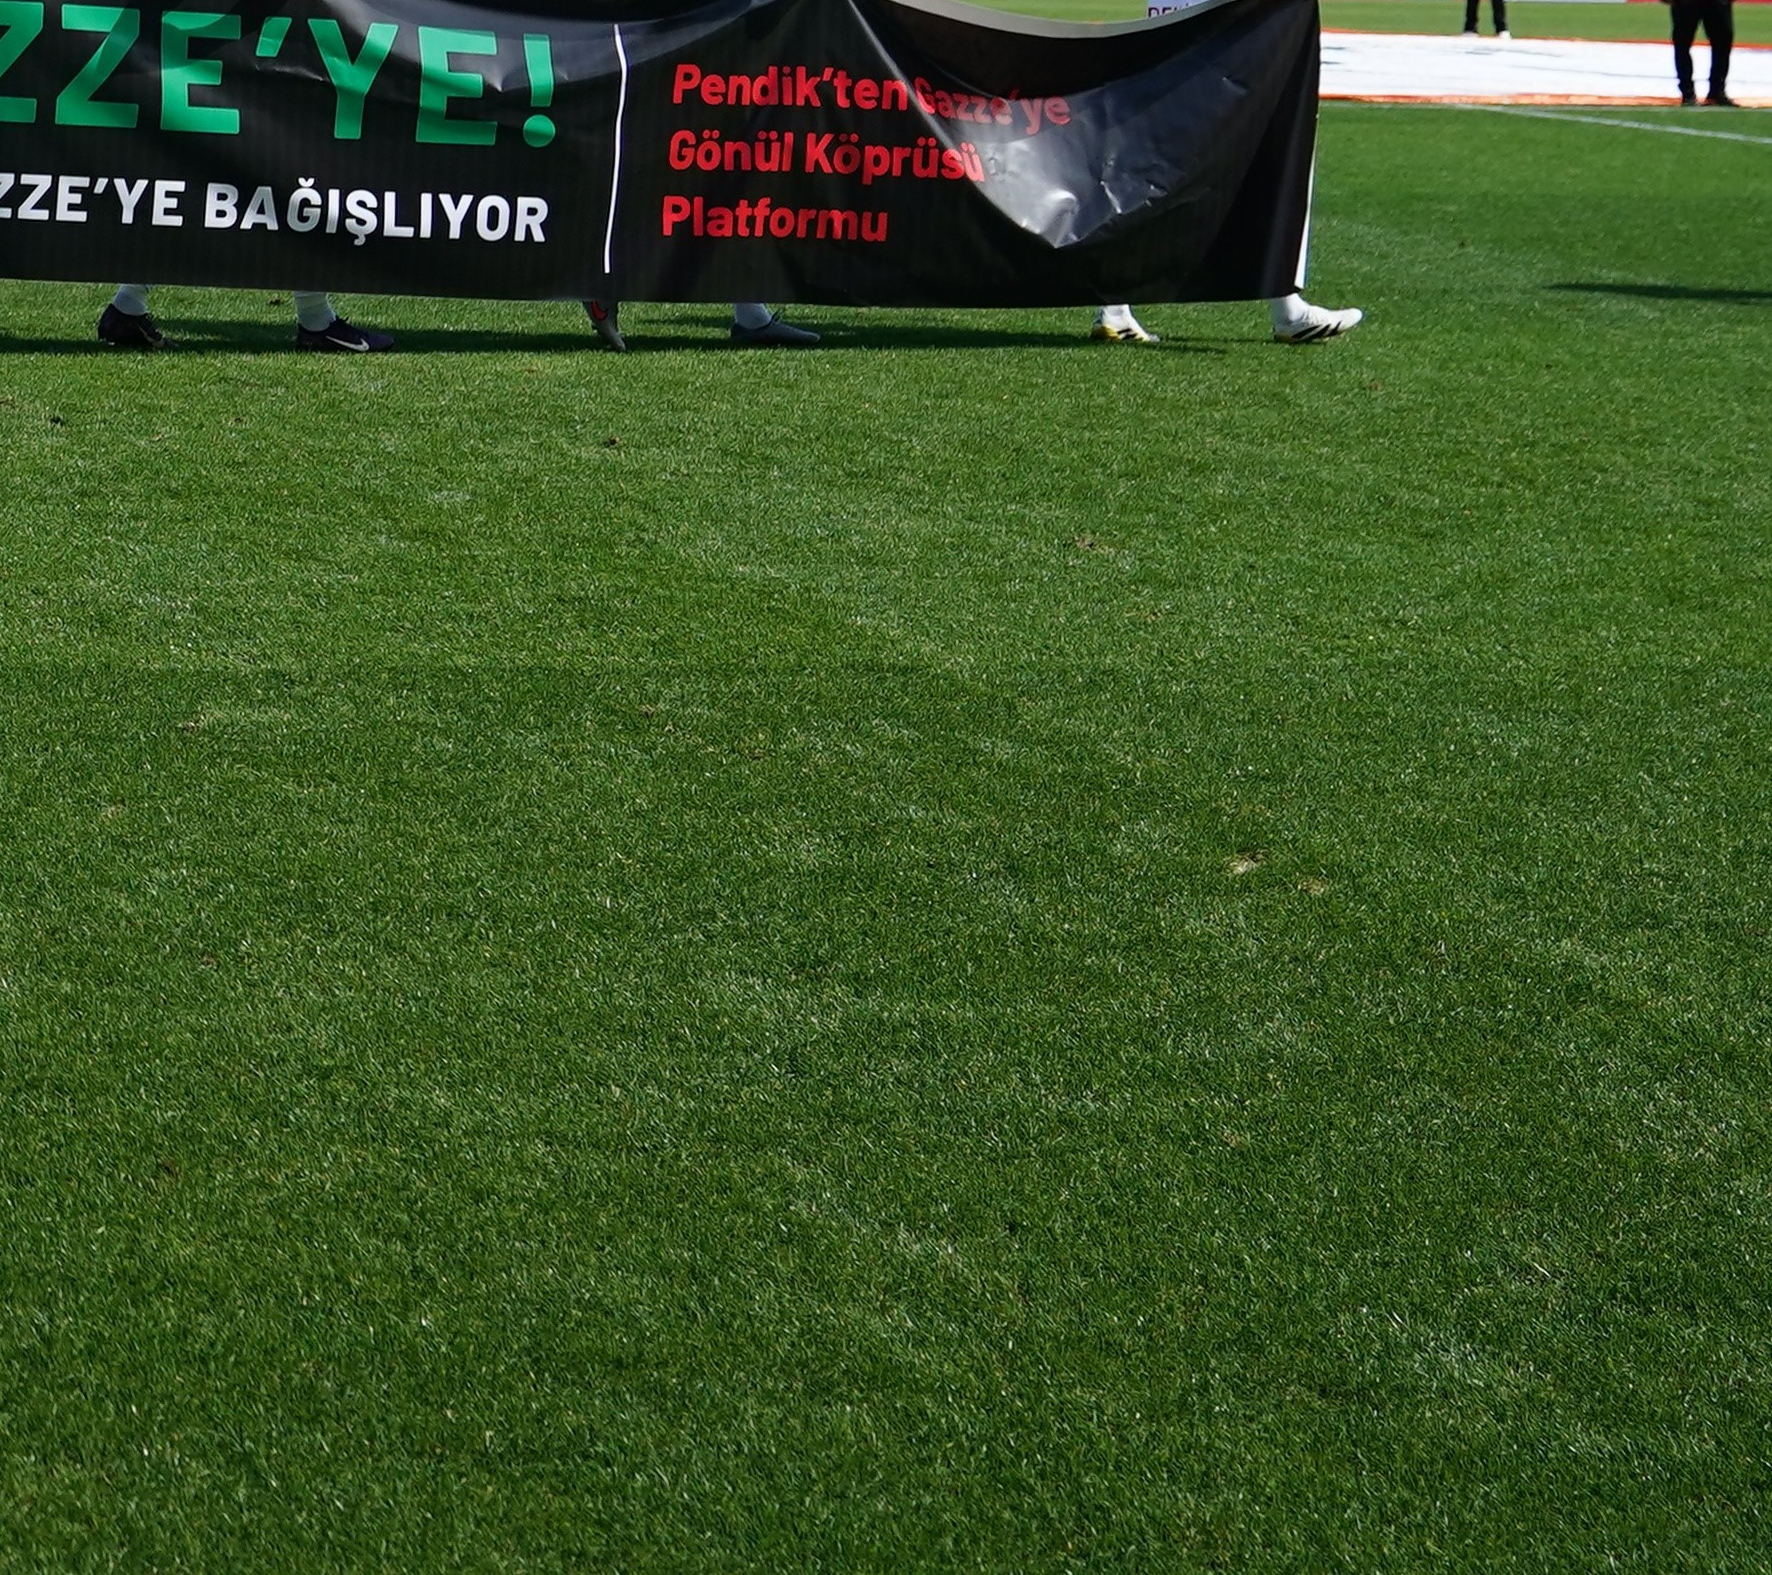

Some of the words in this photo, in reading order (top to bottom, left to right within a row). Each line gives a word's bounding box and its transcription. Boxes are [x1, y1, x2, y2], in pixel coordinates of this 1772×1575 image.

[671, 63, 908, 112] Pendik'ten
[913, 76, 1071, 136] Gazze'ye
[667, 128, 793, 174] Gönül
[804, 131, 986, 186] Köprüsü
[205, 178, 550, 247] BAĞIŞLIYOR
[660, 193, 889, 244] Platformu
